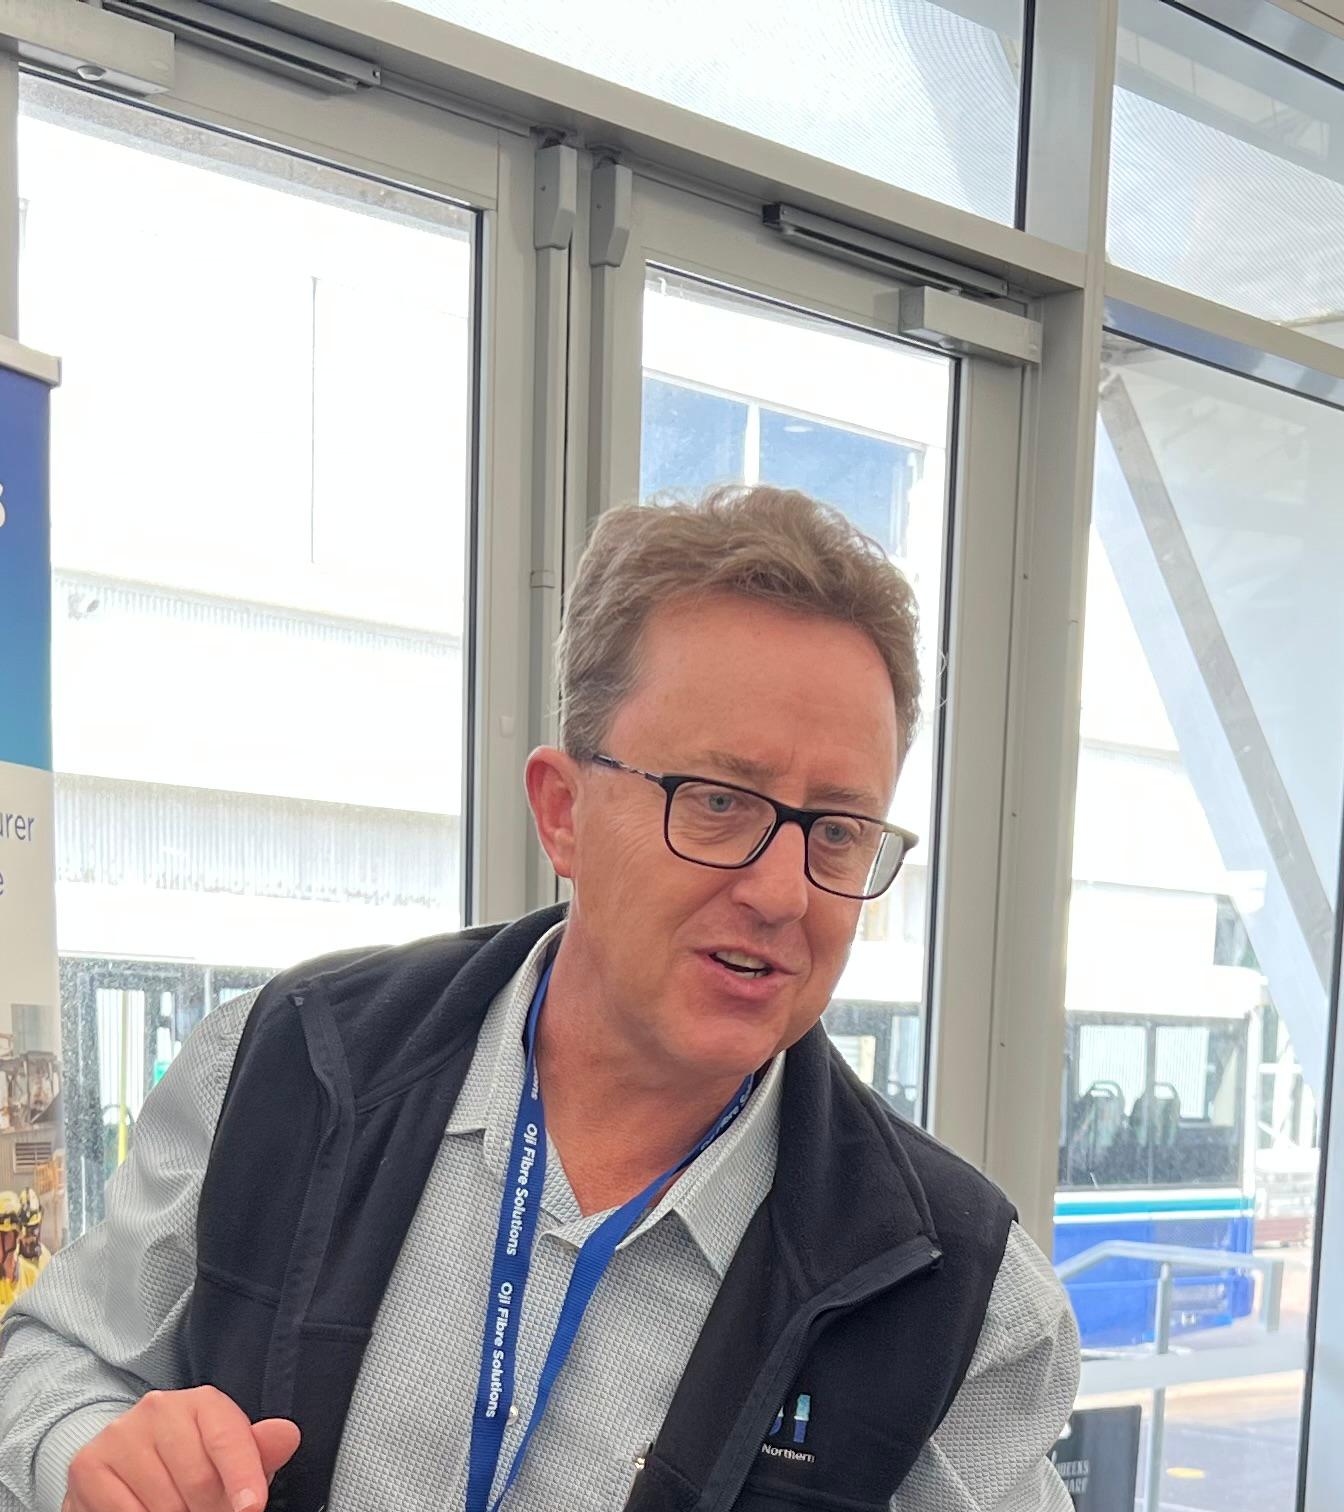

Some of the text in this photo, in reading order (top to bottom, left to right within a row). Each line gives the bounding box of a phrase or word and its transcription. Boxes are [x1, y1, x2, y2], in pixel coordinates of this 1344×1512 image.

[506, 1123, 538, 1256] Oji Fibre Solutions
[485, 1281, 513, 1419] Oji Fibre Solutions
[761, 1443, 816, 1463] Northern
